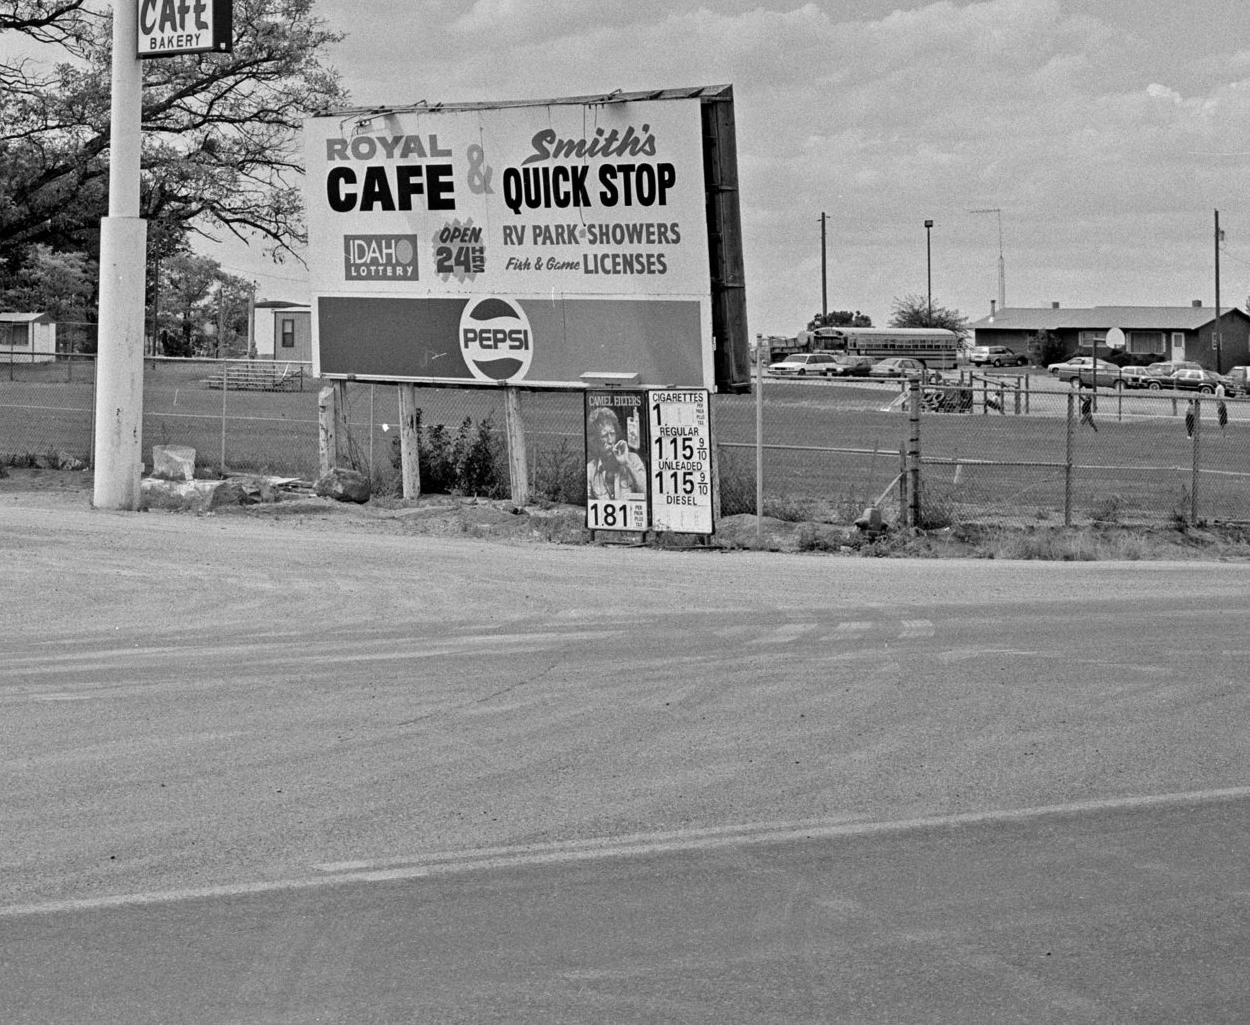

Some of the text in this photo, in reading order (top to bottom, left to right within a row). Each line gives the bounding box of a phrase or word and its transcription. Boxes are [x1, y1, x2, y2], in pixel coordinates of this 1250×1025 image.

[150, 33, 201, 50] BAKERY
[326, 134, 453, 161] ROYAL
[521, 123, 657, 167] Smith's
[467, 143, 495, 194] &
[326, 164, 456, 213] CAFE
[503, 162, 676, 214] QUICK STOP
[439, 227, 483, 244] OPEN
[503, 222, 681, 245] RV PARK SHOWERS
[350, 239, 414, 265] IDAHO
[436, 246, 471, 274] 24
[351, 266, 414, 277] LOTTERY
[506, 253, 668, 275] Fish & Game LICENSES
[463, 328, 529, 351] PEPSI
[589, 396, 641, 407] CAMEL FILTERS
[652, 393, 704, 402] CIGARETTES
[659, 427, 699, 436] REGULAR
[658, 461, 703, 471] UNLEADED
[666, 496, 697, 506] DIESEL
[590, 503, 628, 527] 1.81
